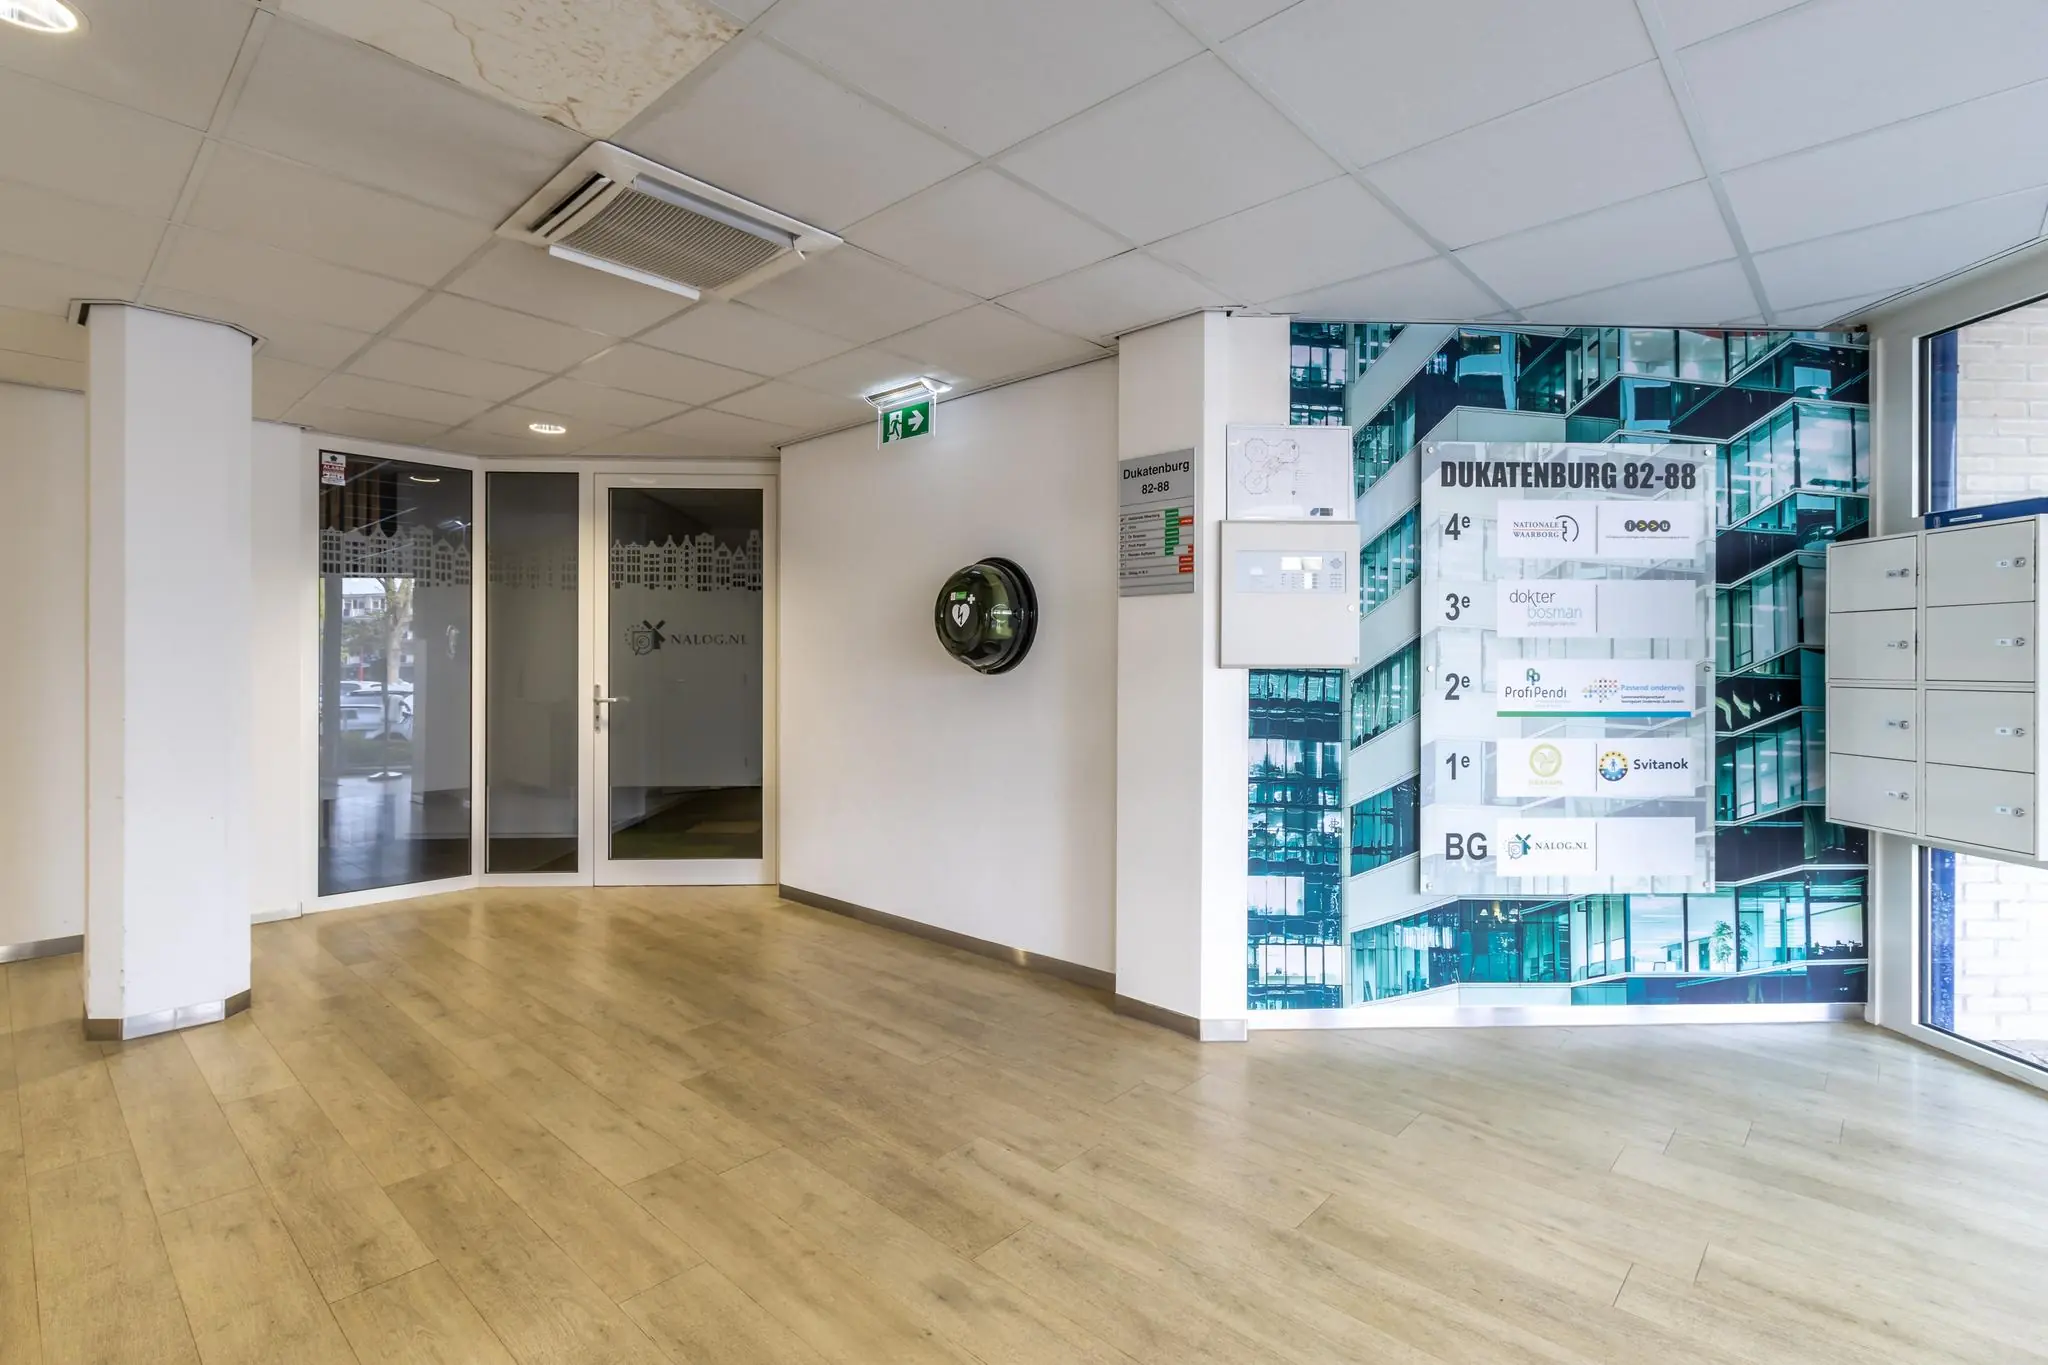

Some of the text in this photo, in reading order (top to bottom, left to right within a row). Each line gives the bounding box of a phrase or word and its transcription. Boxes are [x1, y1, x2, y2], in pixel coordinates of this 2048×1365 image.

[1123, 461, 1190, 480] Dukatenburg
[1441, 461, 1696, 489] DUKATENBURG 82-88
[1141, 481, 1170, 494] 82-88
[1509, 589, 1556, 607] dokter
[1527, 604, 1583, 619] bosman
[670, 634, 748, 645] NALOG.NL
[1620, 684, 1685, 692] Passend onderwijs
[1633, 758, 1688, 770] Svitanok
[1445, 832, 1488, 861] BG
[1535, 842, 1588, 850] NALOG.NL
